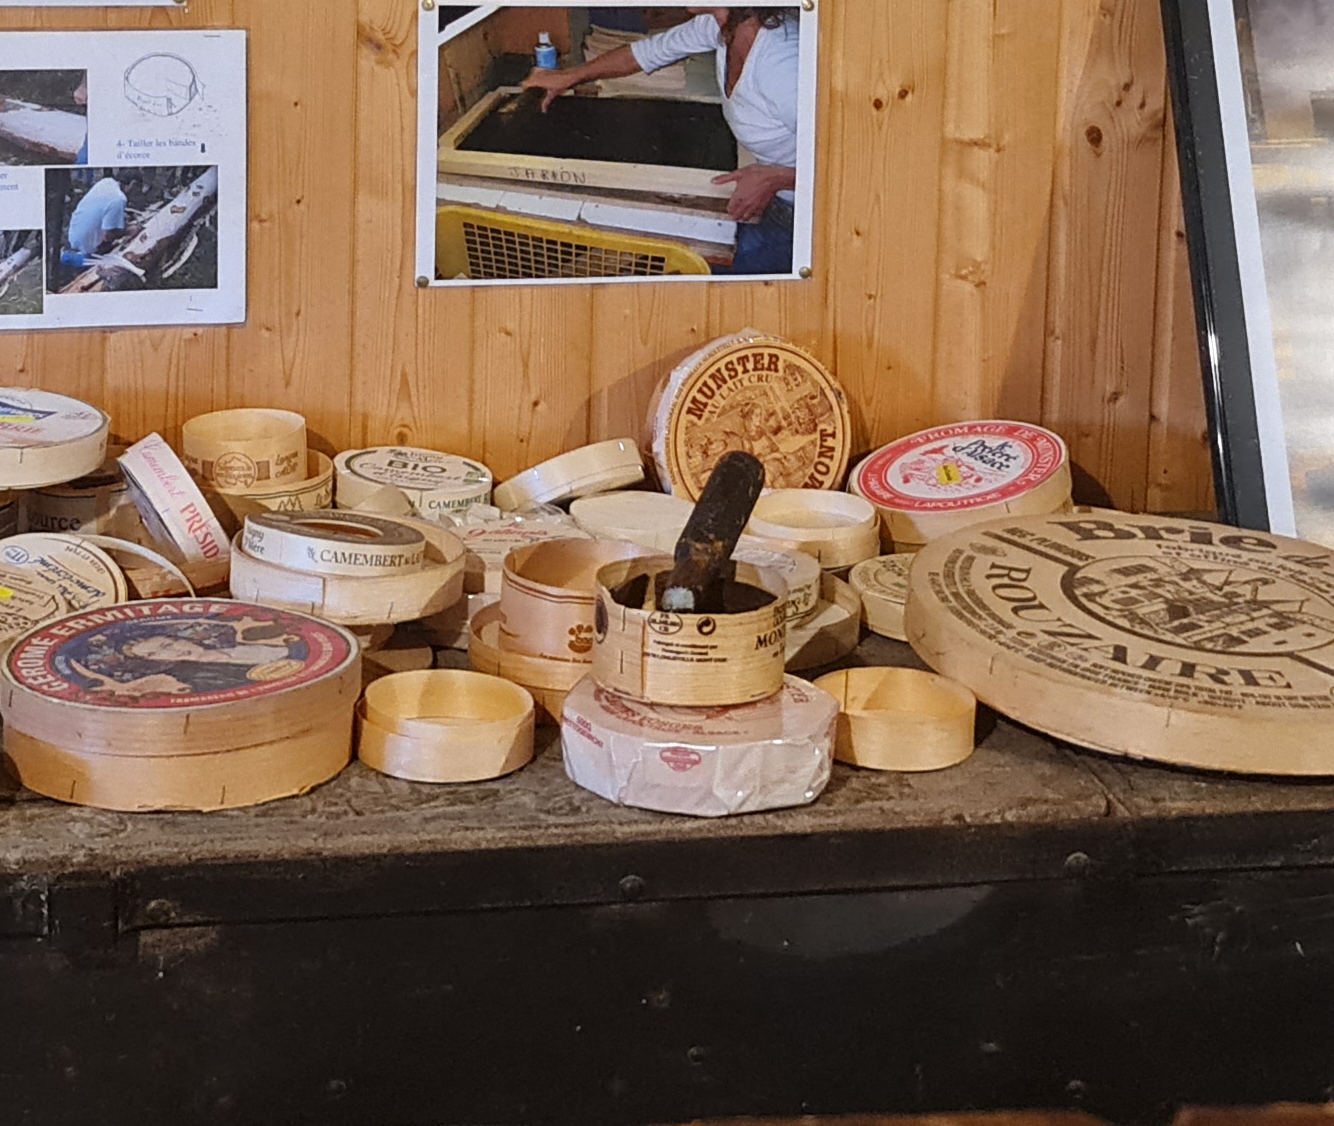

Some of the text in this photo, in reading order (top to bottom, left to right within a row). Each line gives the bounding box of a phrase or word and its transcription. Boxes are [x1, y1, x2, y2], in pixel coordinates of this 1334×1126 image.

[116, 150, 152, 160] d'écorce
[128, 138, 154, 148] Tailler
[155, 138, 167, 148] les
[167, 138, 197, 148] bandes
[686, 352, 780, 421] MUNSTER
[708, 373, 773, 417] AU LAIT CRU
[1014, 428, 1037, 439] DE
[387, 459, 447, 474] BIO
[1046, 519, 1278, 554] Brie
[1274, 554, 1331, 569] de
[320, 549, 404, 568] CAMEMBERT
[56, 602, 234, 637] ERMITAGE
[984, 561, 1293, 690] ROUZAIRE
